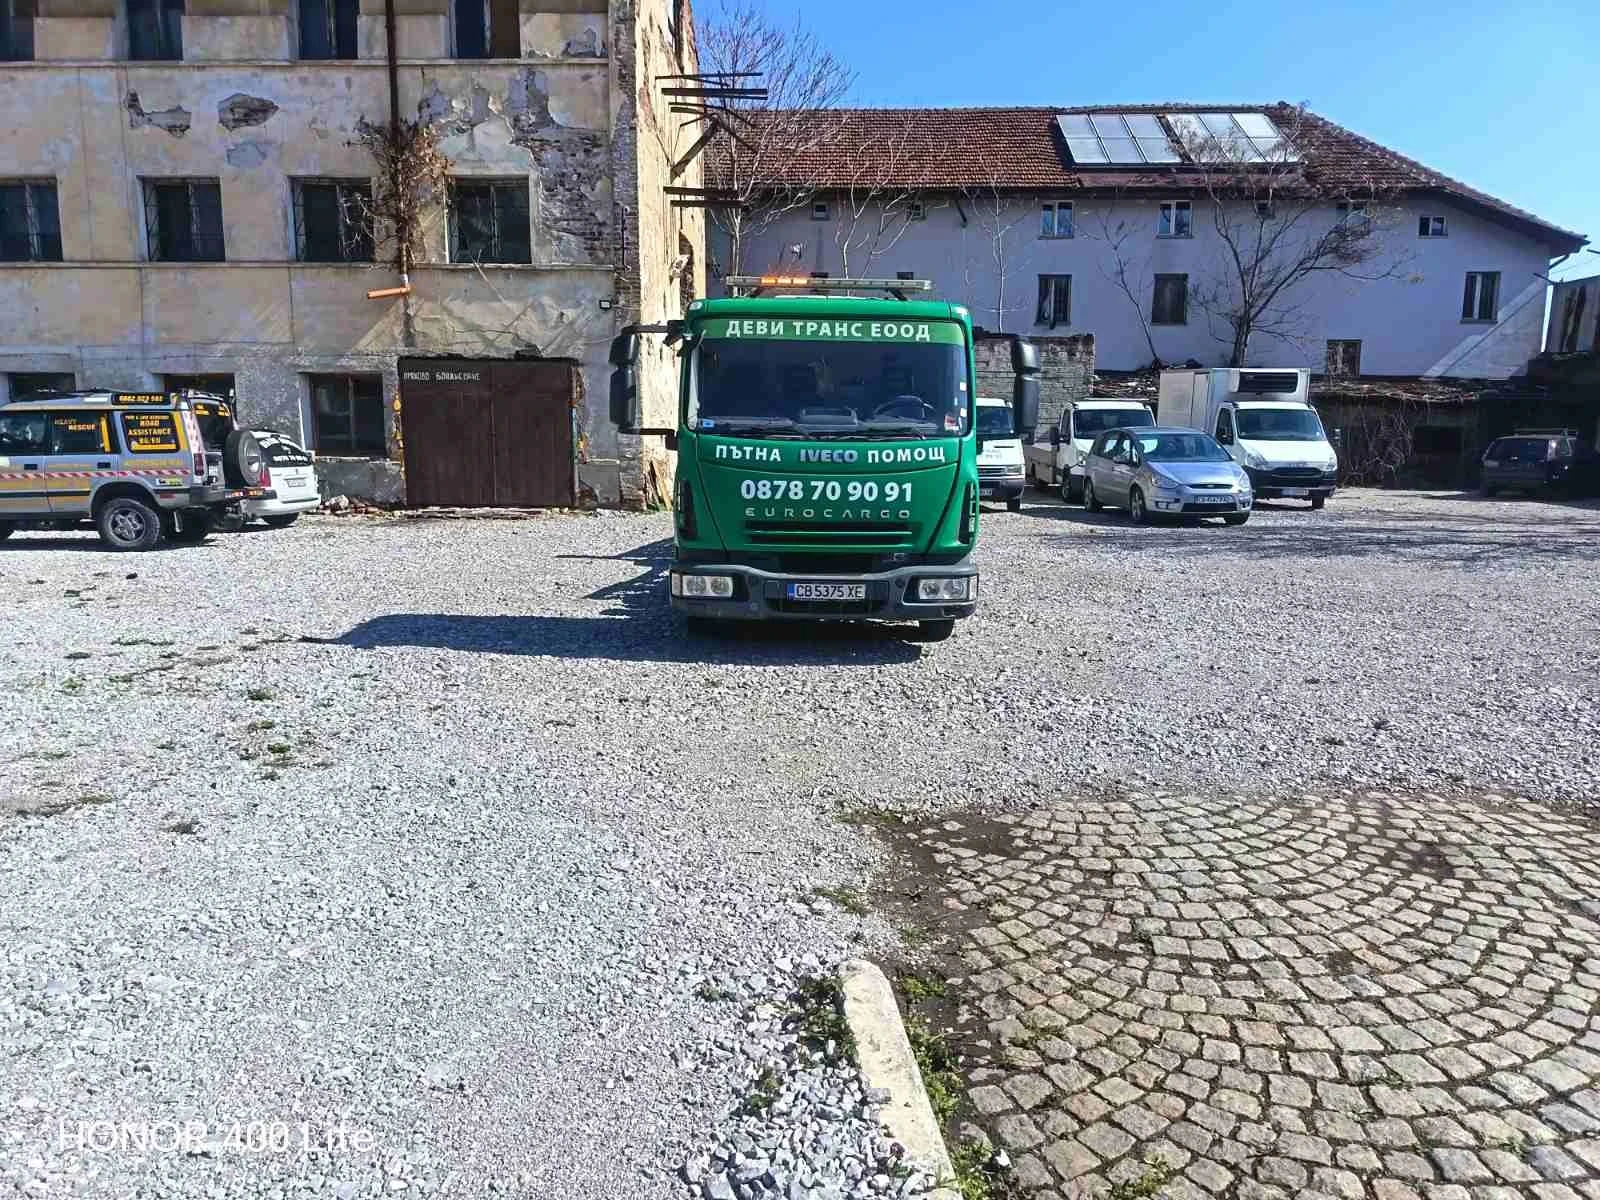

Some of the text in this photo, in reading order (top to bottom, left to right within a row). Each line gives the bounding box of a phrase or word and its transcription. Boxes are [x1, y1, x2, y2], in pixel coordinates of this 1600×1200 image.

[725, 320, 931, 342] ДЕВИ ТРАНС ЕООД
[139, 420, 160, 428] ROAD
[128, 428, 171, 436] ASSISTANCE
[715, 444, 945, 463] ПЪТНА ПОМОЩ
[799, 448, 858, 463] IVECO
[740, 479, 913, 503] 0878 70 90 91
[744, 507, 911, 520] EUROCARGO
